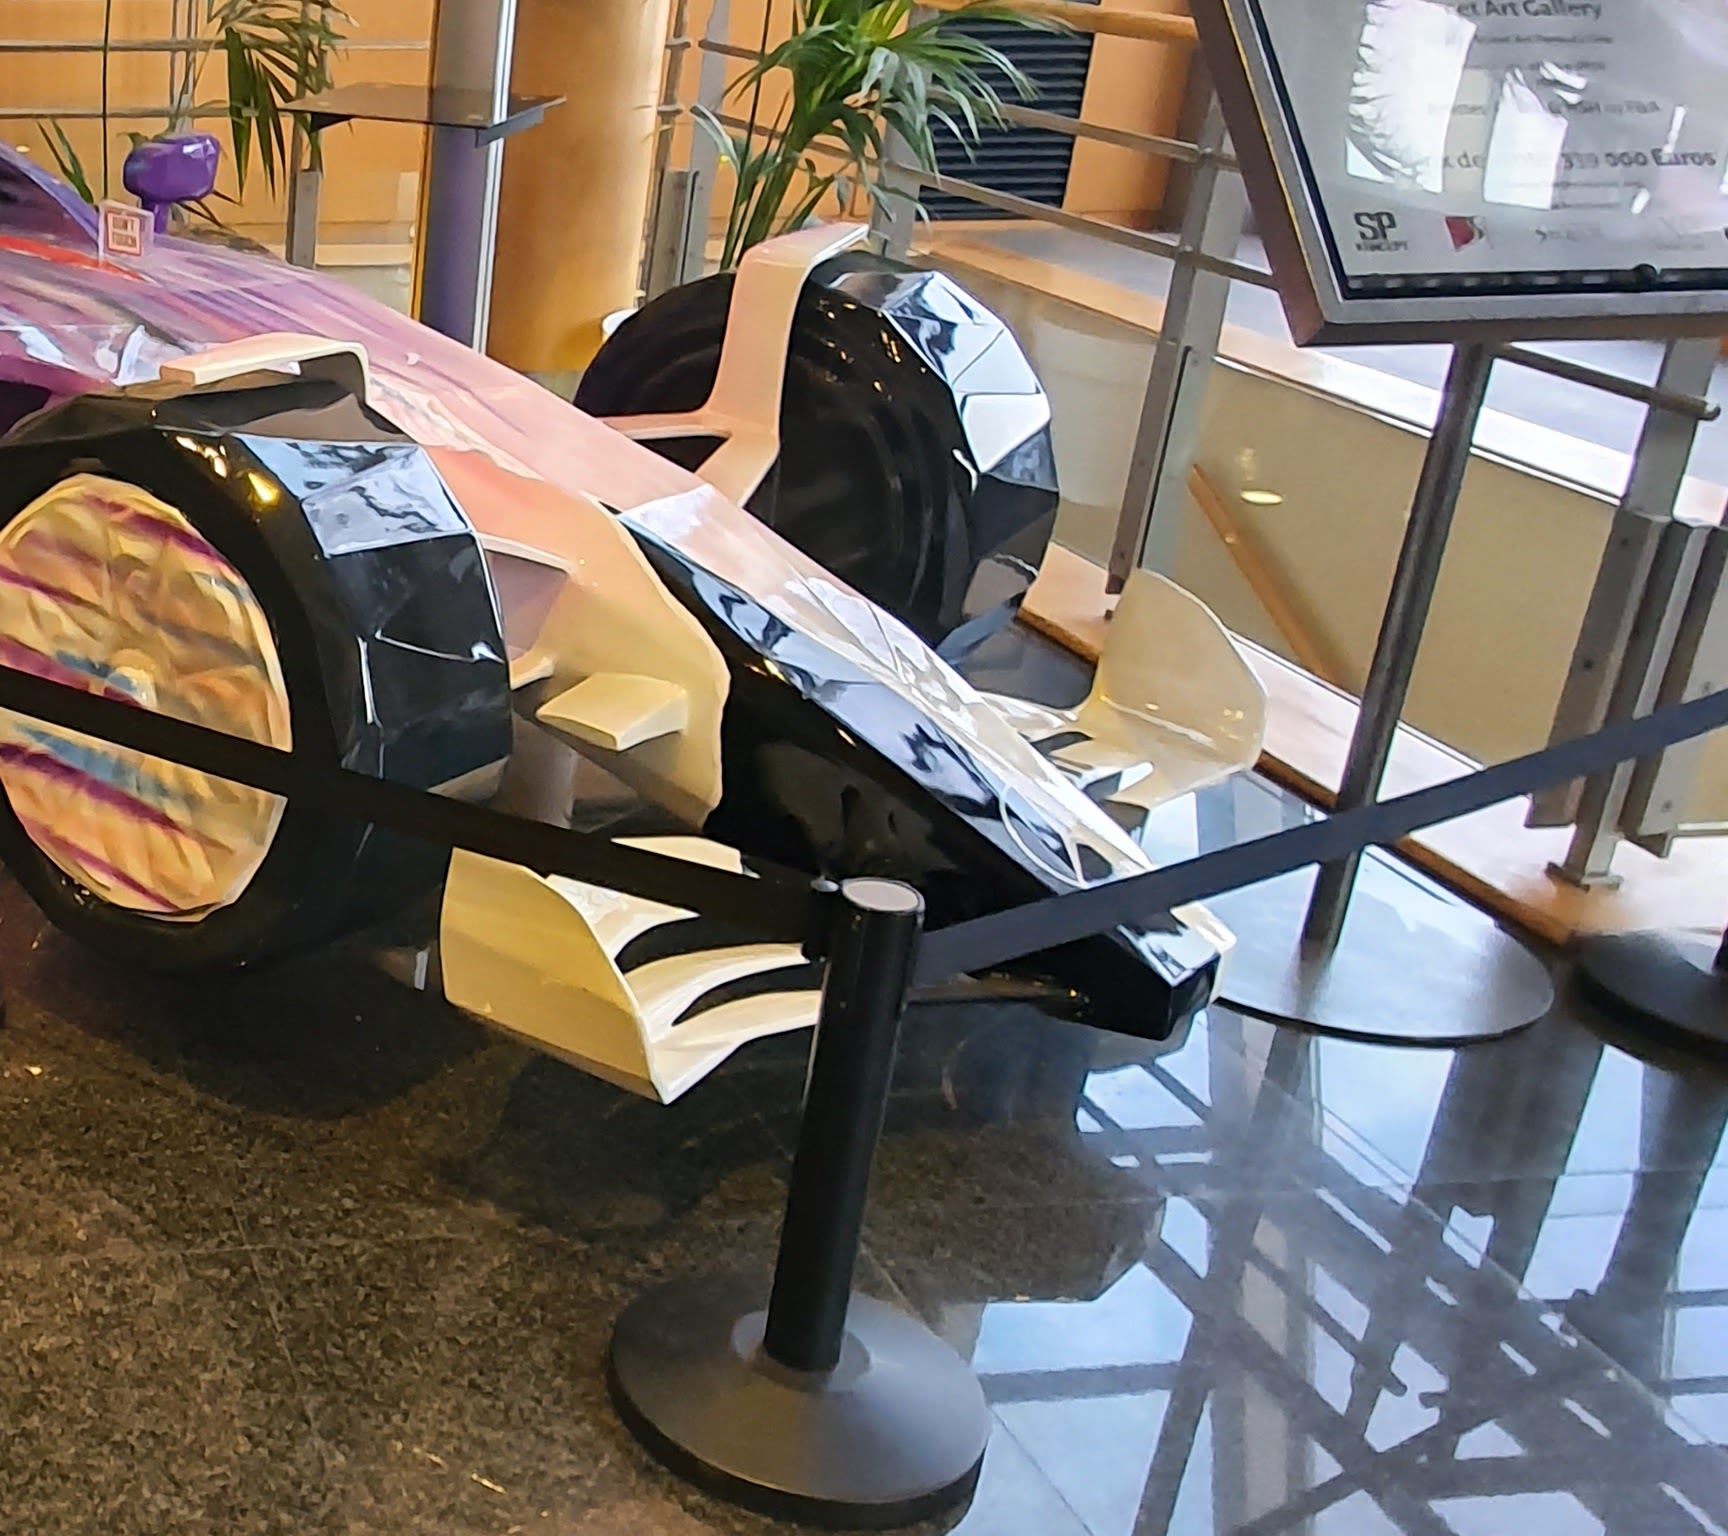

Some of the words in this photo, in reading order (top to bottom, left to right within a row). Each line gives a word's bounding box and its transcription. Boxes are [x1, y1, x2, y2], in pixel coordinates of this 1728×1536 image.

[1485, 0, 1519, 17] Art
[1650, 148, 1716, 166] Euros
[1354, 212, 1396, 241] SP
